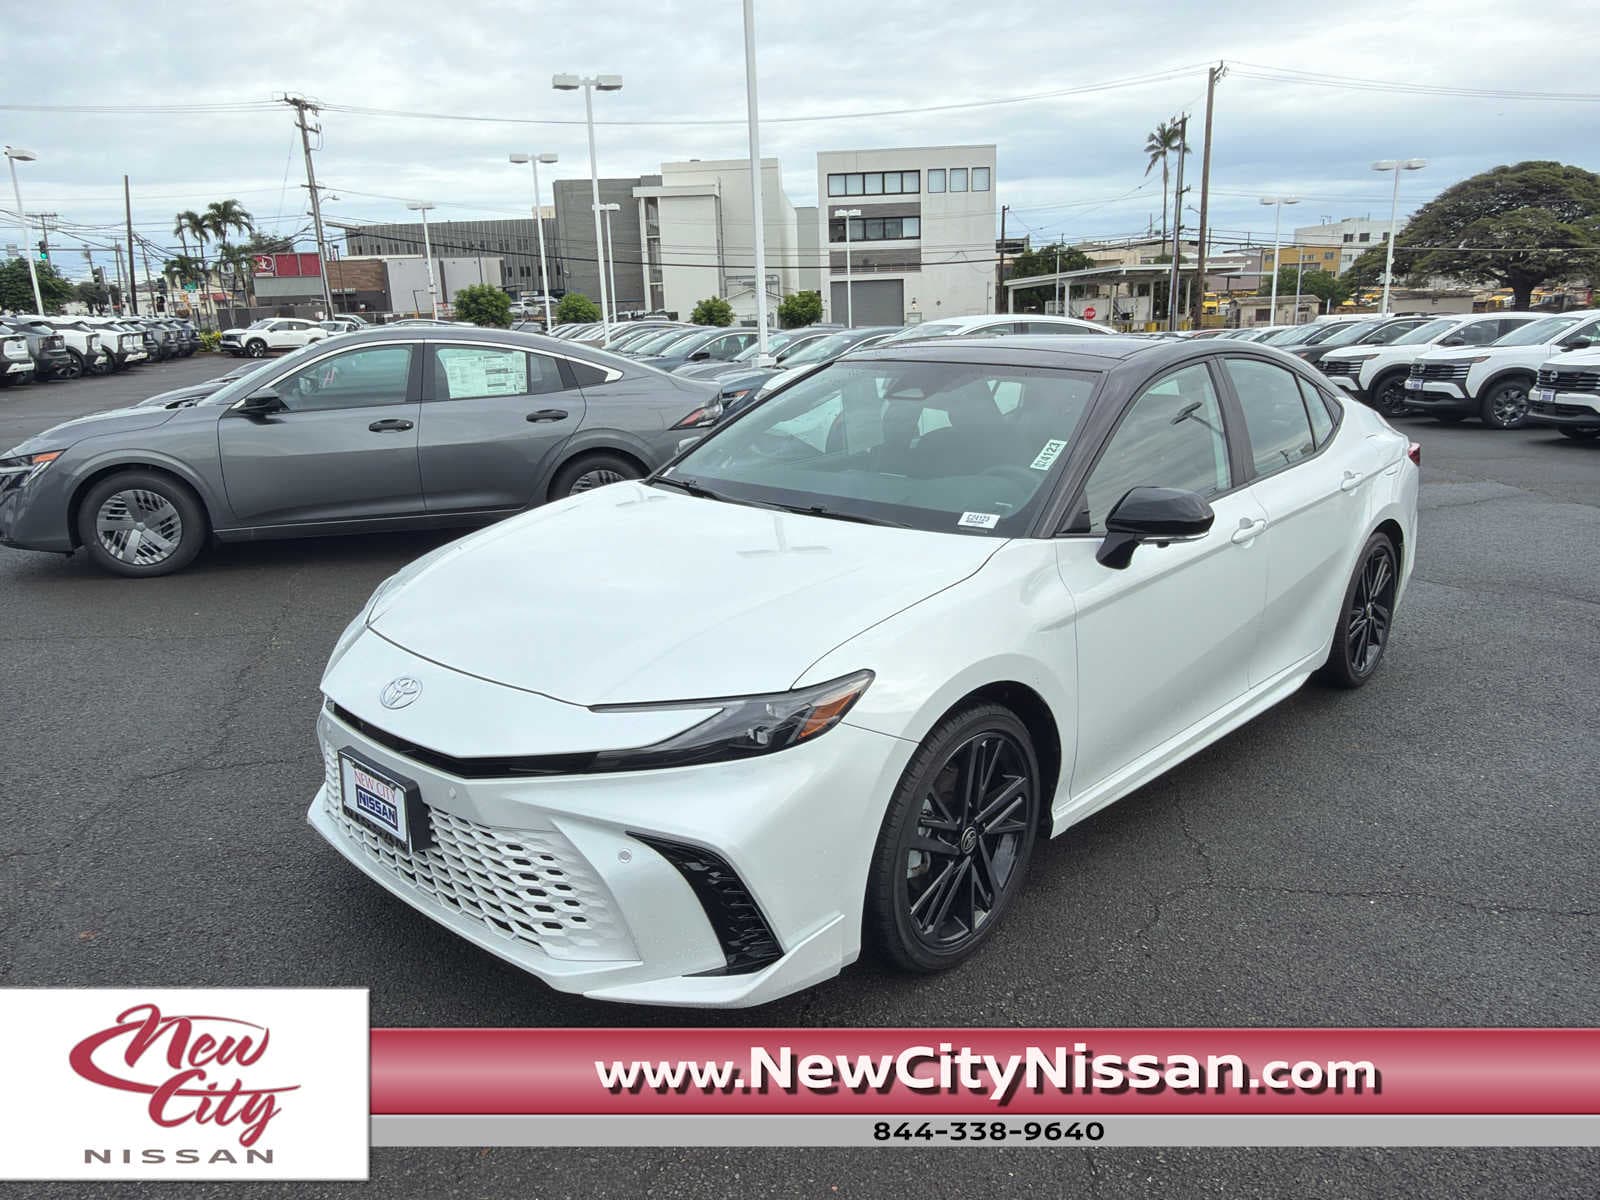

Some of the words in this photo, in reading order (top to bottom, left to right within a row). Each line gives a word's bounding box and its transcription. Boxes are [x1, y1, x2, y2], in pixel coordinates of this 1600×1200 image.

[353, 769, 374, 791] NEW
[375, 781, 396, 803] CITY
[359, 791, 397, 824] NISSAN
